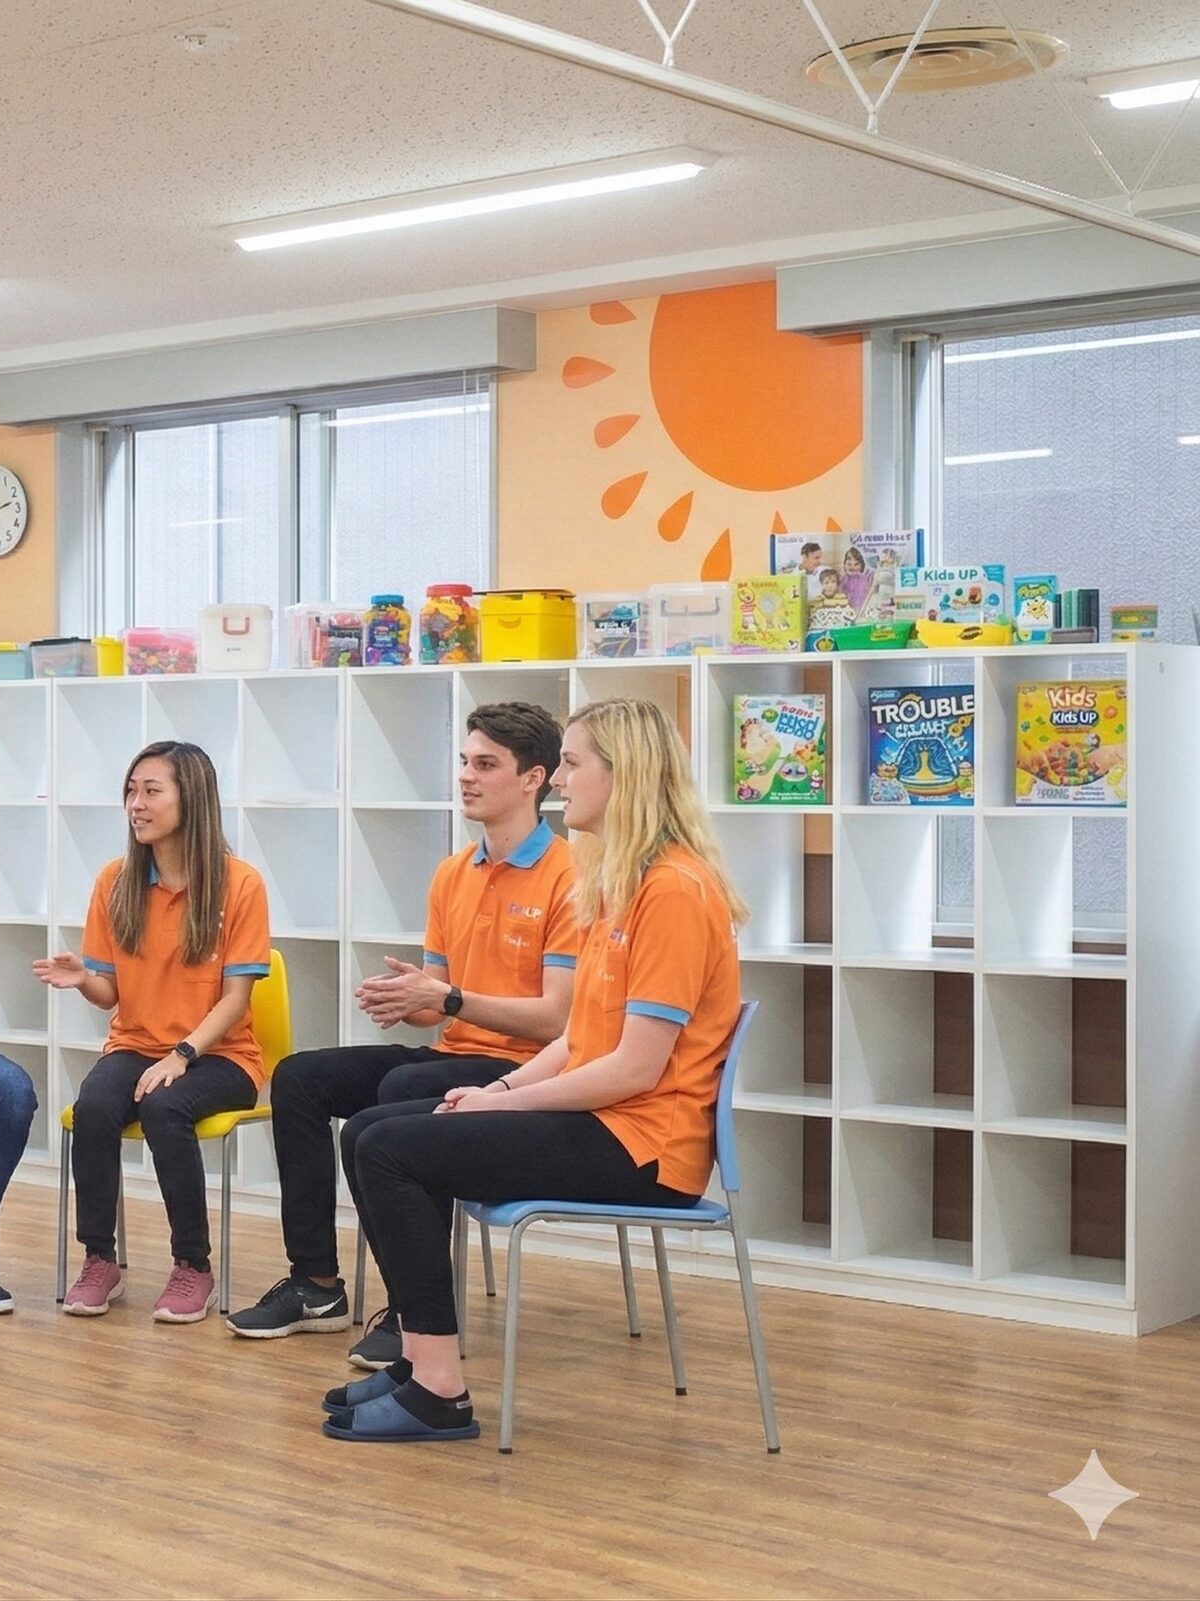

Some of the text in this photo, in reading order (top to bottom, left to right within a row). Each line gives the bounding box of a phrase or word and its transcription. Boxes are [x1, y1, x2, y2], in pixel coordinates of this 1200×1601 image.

[11, 487, 17, 498] 2
[15, 502, 21, 513] 3
[14, 518, 20, 528] 4
[6, 530, 12, 541] 5
[924, 569, 955, 581] Kids
[958, 569, 978, 580] UP
[1047, 685, 1098, 709] Kids
[871, 694, 975, 724] TROUBLE
[1051, 711, 1097, 724] Kids UP
